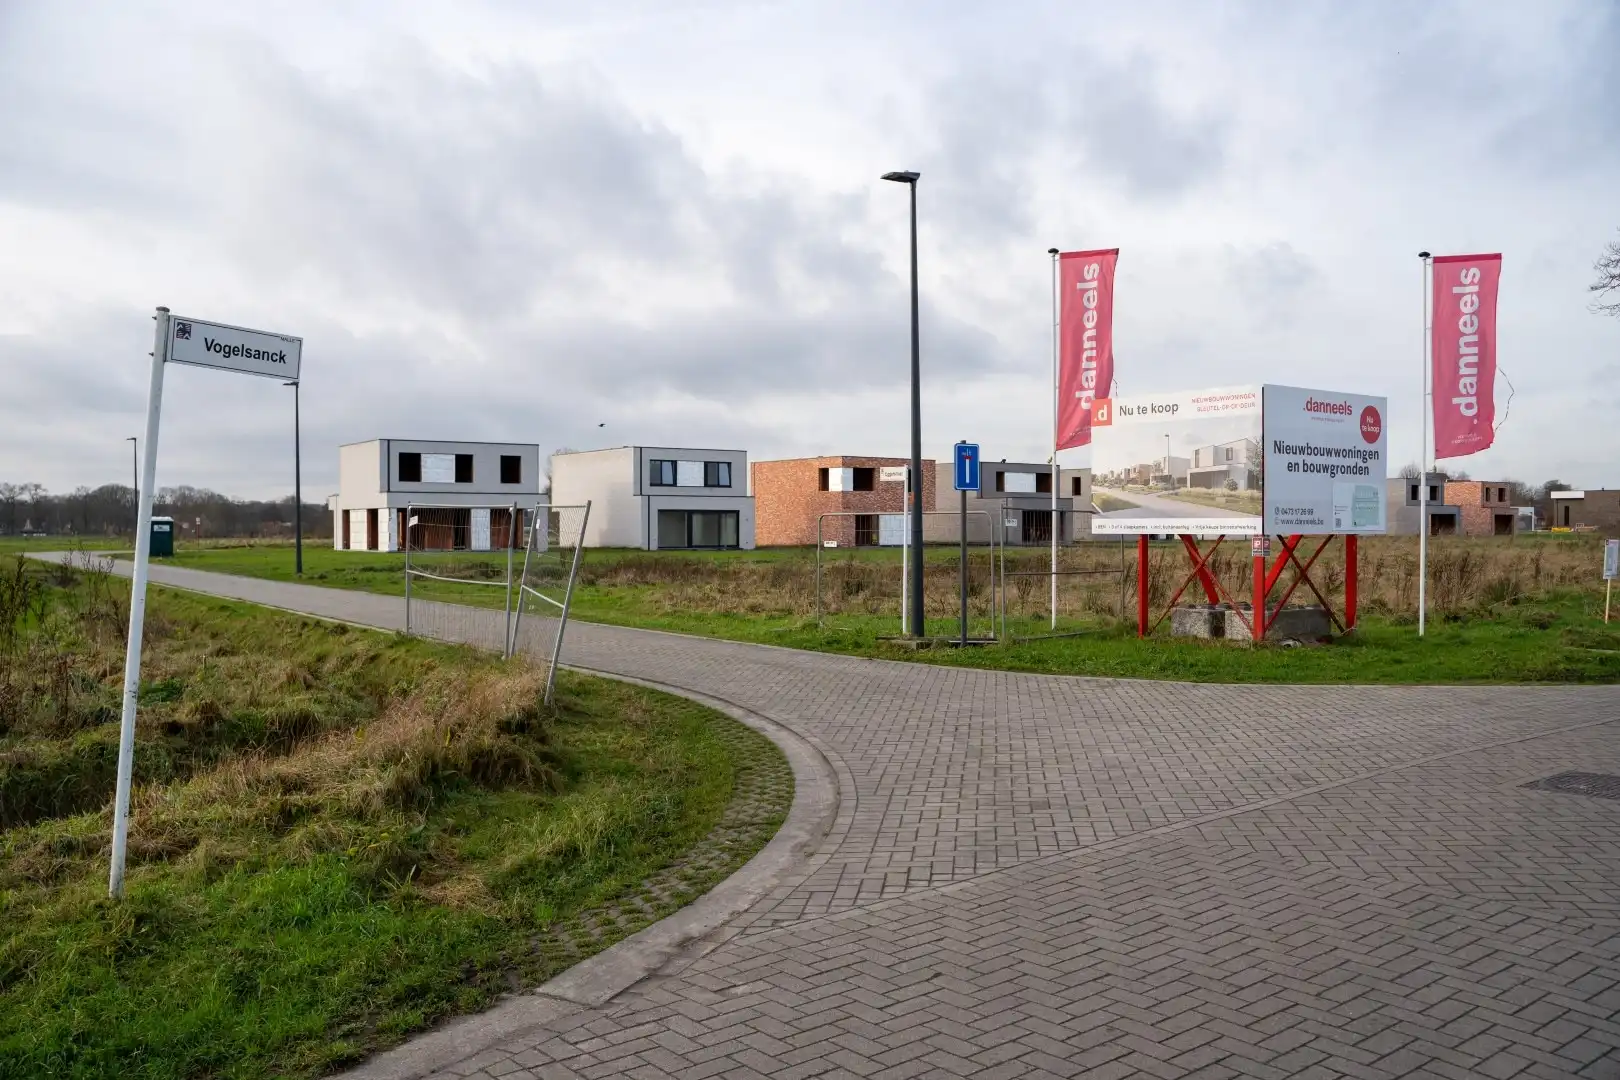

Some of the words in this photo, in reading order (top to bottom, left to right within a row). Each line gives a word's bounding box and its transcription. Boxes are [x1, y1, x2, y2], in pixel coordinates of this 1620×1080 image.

[204, 337, 287, 364] Vogelsanck
[1119, 405, 1134, 416] Nu
[1137, 405, 1148, 415] te
[1151, 402, 1179, 415] koop
[1366, 415, 1374, 424] Nu
[1367, 424, 1380, 433] koop
[1273, 440, 1380, 464] Nieuwbouwwoningen
[1287, 460, 1300, 473] en
[1302, 459, 1370, 478] bouwgronden
